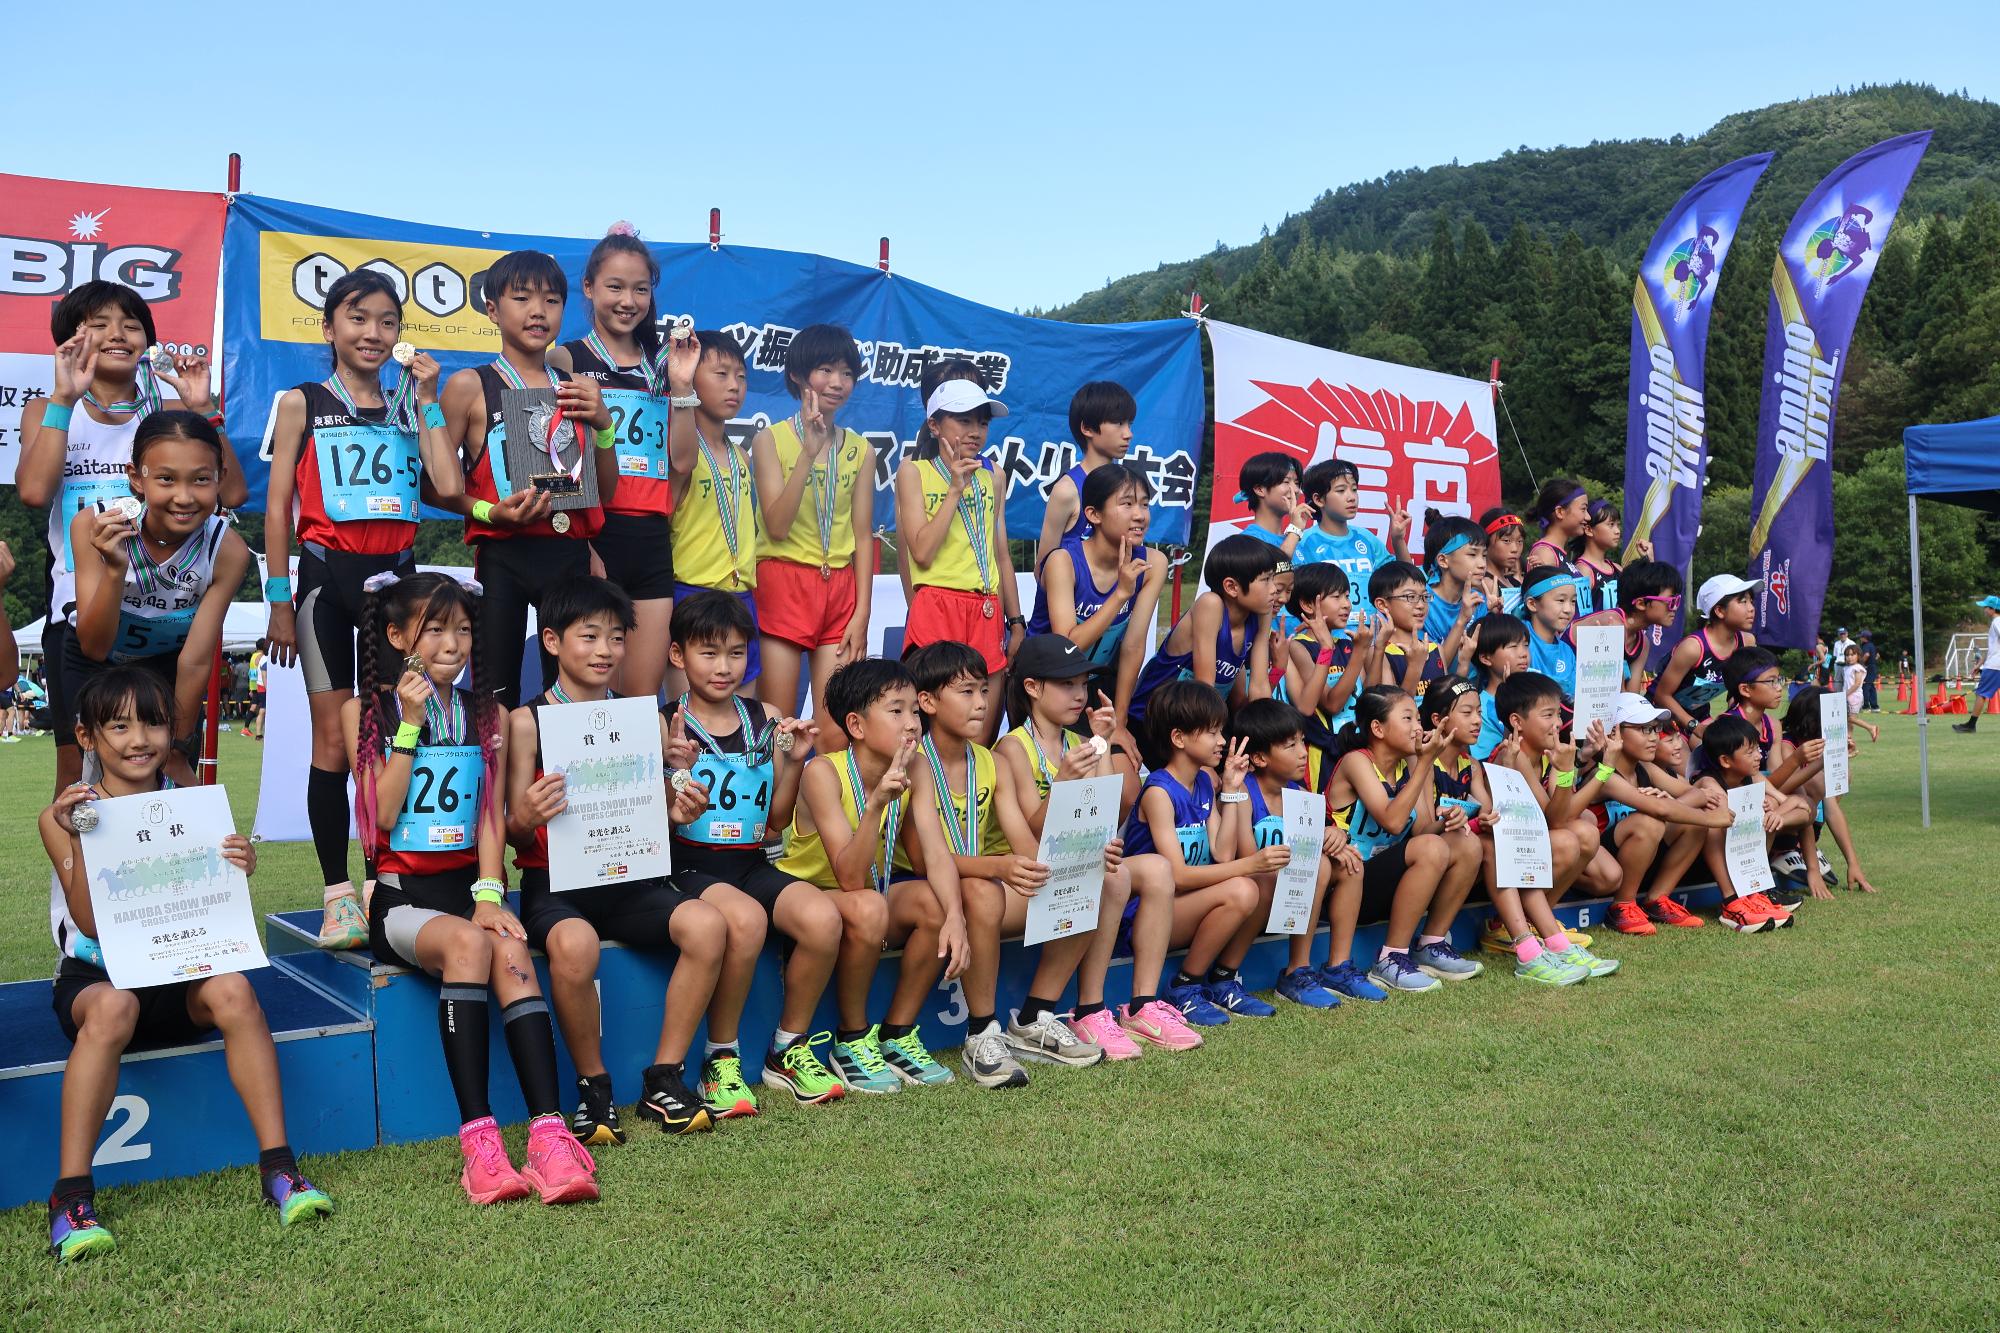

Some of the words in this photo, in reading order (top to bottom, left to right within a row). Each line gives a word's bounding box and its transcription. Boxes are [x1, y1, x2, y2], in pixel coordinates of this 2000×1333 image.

[0, 235, 182, 302] BIG
[1640, 344, 1675, 486] amino
[1774, 322, 1816, 463] amino
[330, 443, 418, 489] 126-5
[113, 905, 163, 925] HAKUBA
[163, 897, 200, 914] SNOW
[201, 891, 232, 907] HARP
[140, 915, 171, 928] CROSS
[171, 907, 210, 922] COUNTRY
[1578, 908, 1591, 928] 6
[937, 976, 970, 1025] 3
[92, 1094, 152, 1167] 2
